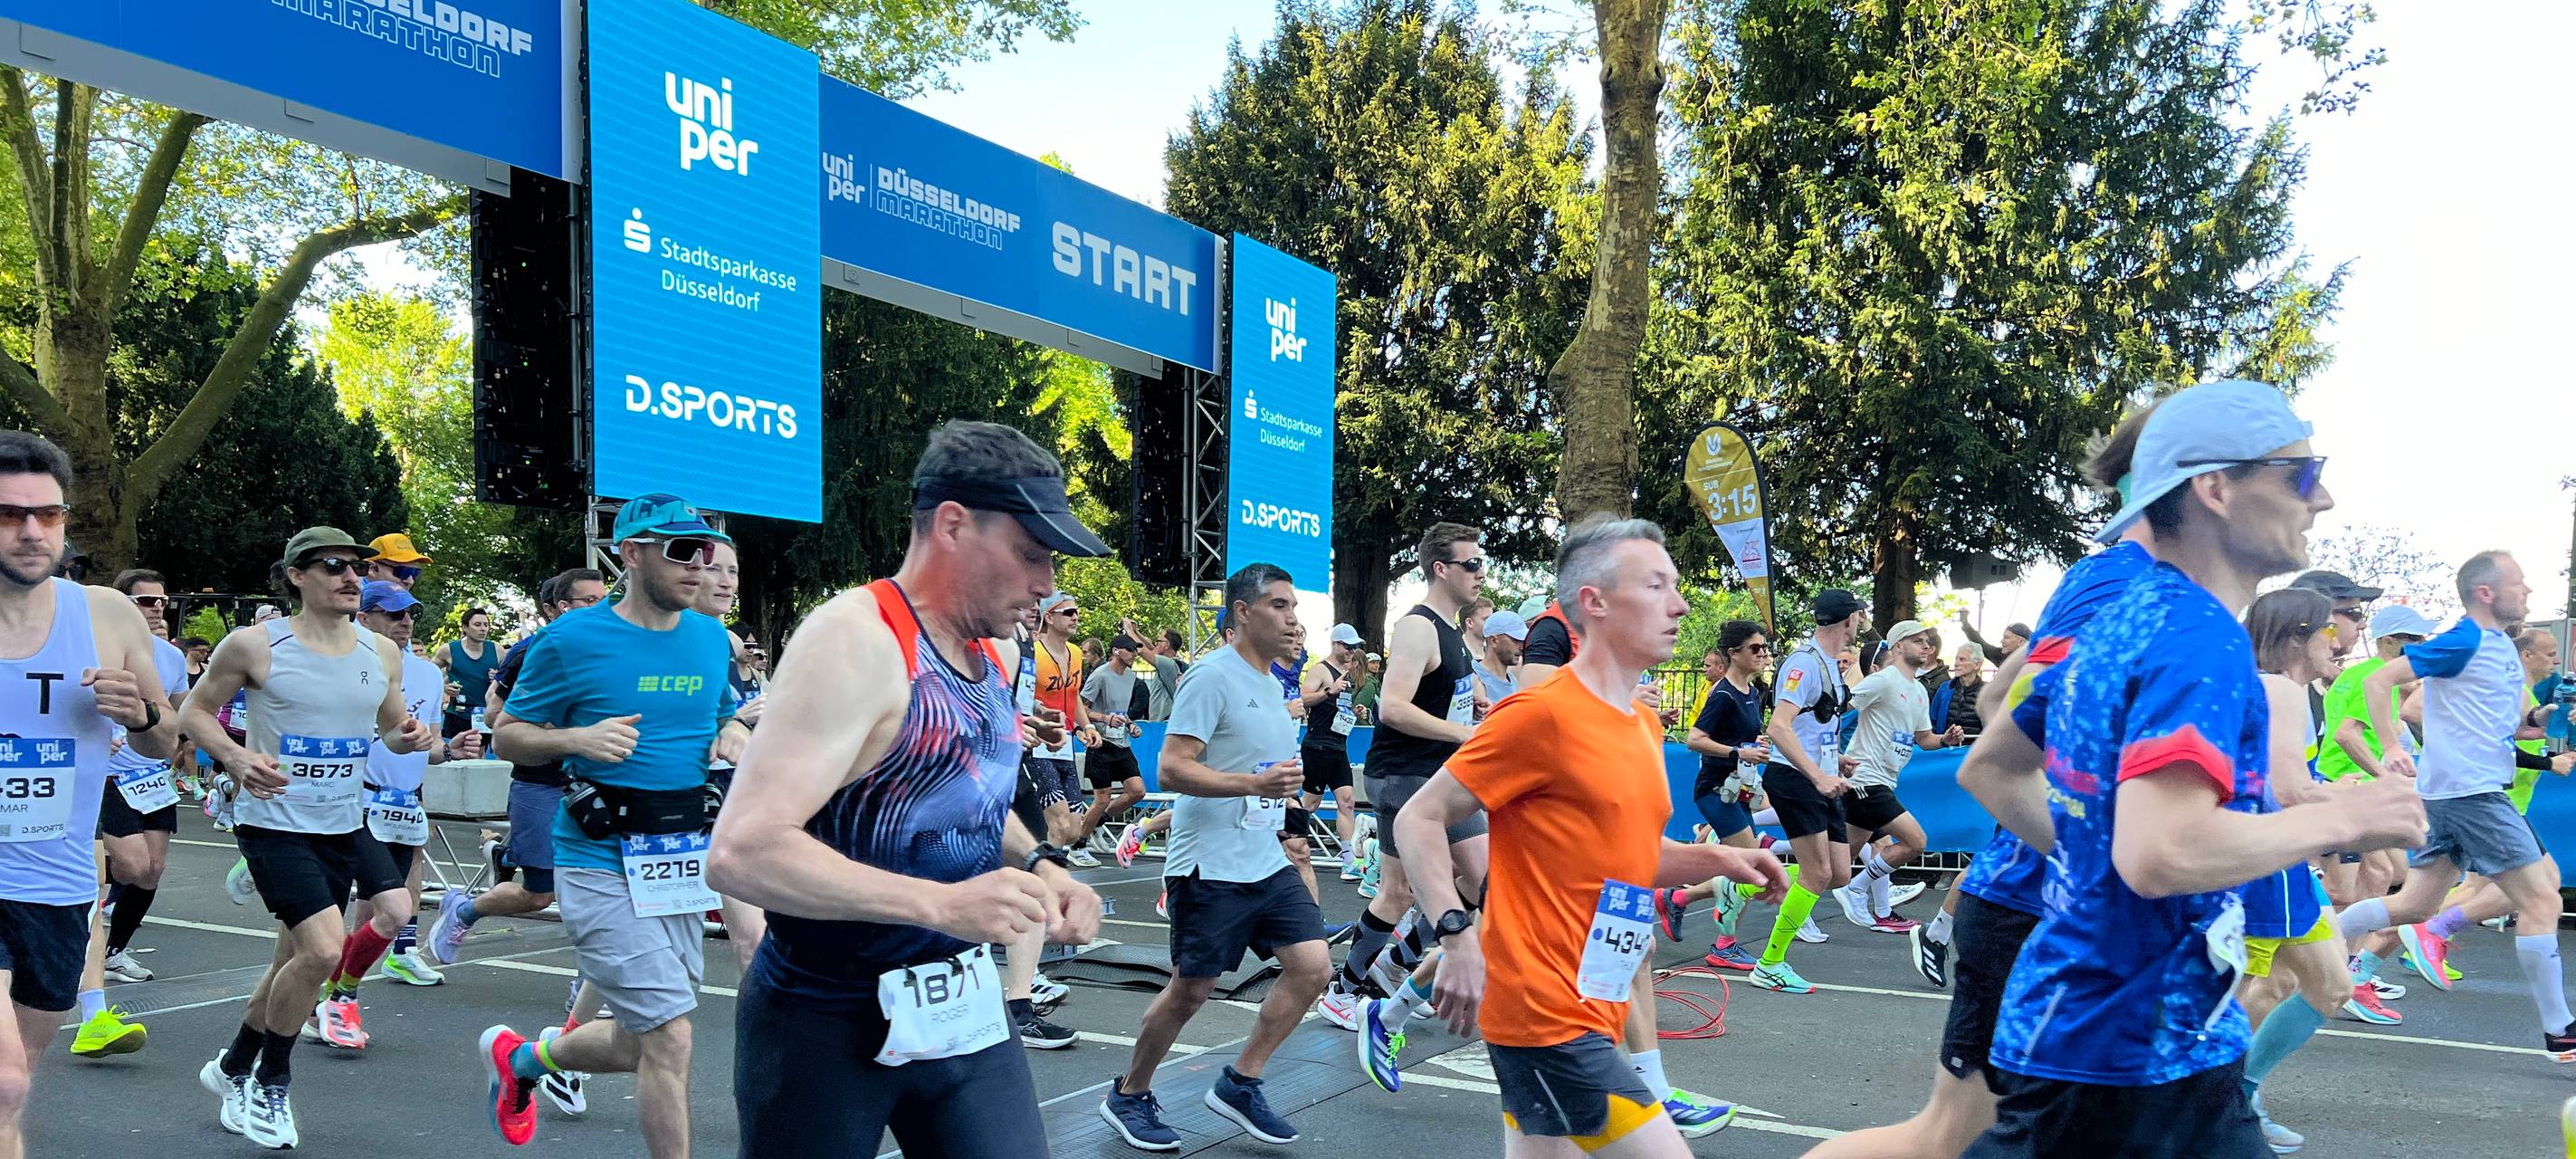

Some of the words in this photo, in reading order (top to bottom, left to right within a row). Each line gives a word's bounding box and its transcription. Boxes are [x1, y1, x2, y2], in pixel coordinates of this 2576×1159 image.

[665, 71, 732, 132] uni
[680, 118, 758, 177] per
[822, 151, 854, 182] uni
[828, 176, 865, 205] per
[877, 167, 1021, 234] DÜSSELDORF
[876, 190, 1003, 251] MARATHON
[660, 237, 797, 292] Stadtsparkasse
[1051, 220, 1197, 316] START
[662, 268, 760, 312] Düsseldorf
[1265, 297, 1296, 333] uni
[1271, 326, 1307, 362] per
[625, 374, 797, 439] D.SPORTS
[1260, 407, 1322, 438] Stadtsparkasse
[1260, 427, 1305, 454] Düsseldorf
[1703, 479, 1720, 492] SUB
[1708, 483, 1758, 521] 3:15
[1242, 500, 1321, 538] D.SPORTS
[25, 672, 64, 714] T
[661, 675, 703, 696] cep
[36, 740, 59, 752] uni
[40, 751, 68, 764] per
[291, 762, 353, 779] 3673
[0, 777, 56, 799] 33
[21, 823, 65, 835] D.SPORTS
[381, 809, 424, 824] 1940
[930, 1003, 969, 1025] ROGER
